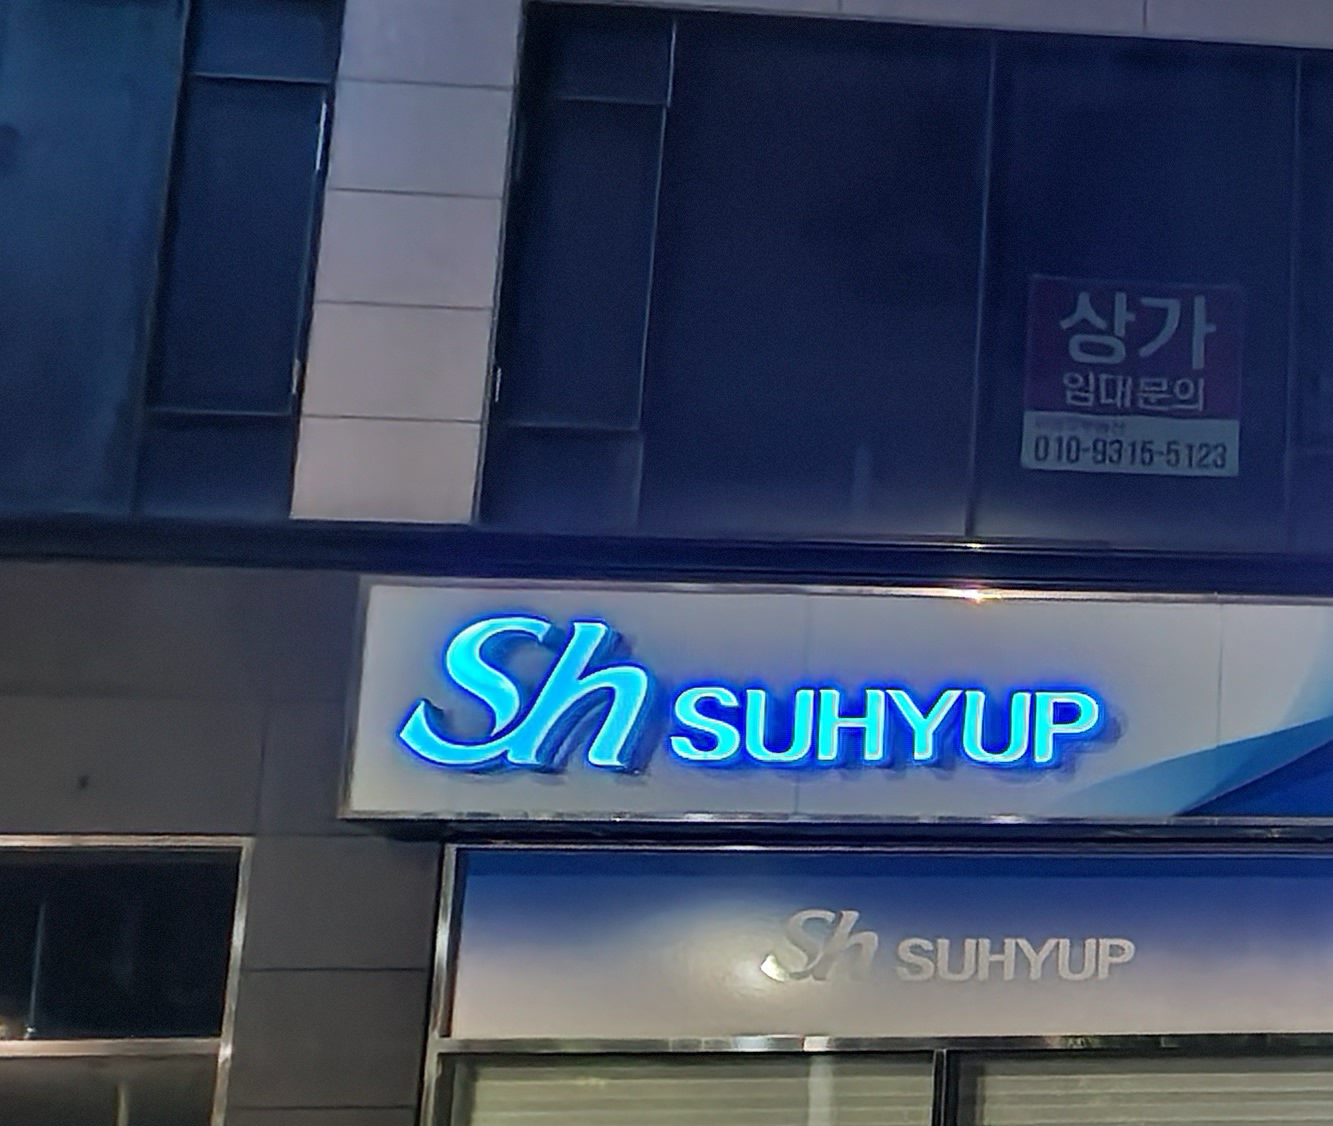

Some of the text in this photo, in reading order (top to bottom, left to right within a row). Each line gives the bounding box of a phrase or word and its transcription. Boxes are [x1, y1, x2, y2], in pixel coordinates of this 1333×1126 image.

[1060, 291, 1216, 370] 상가
[1062, 371, 1205, 412] 임대문의
[1033, 435, 1228, 469] 010-9315-5123
[400, 614, 1100, 769] Sh SUHYUP
[760, 908, 1136, 982] Sh SUHYUP
